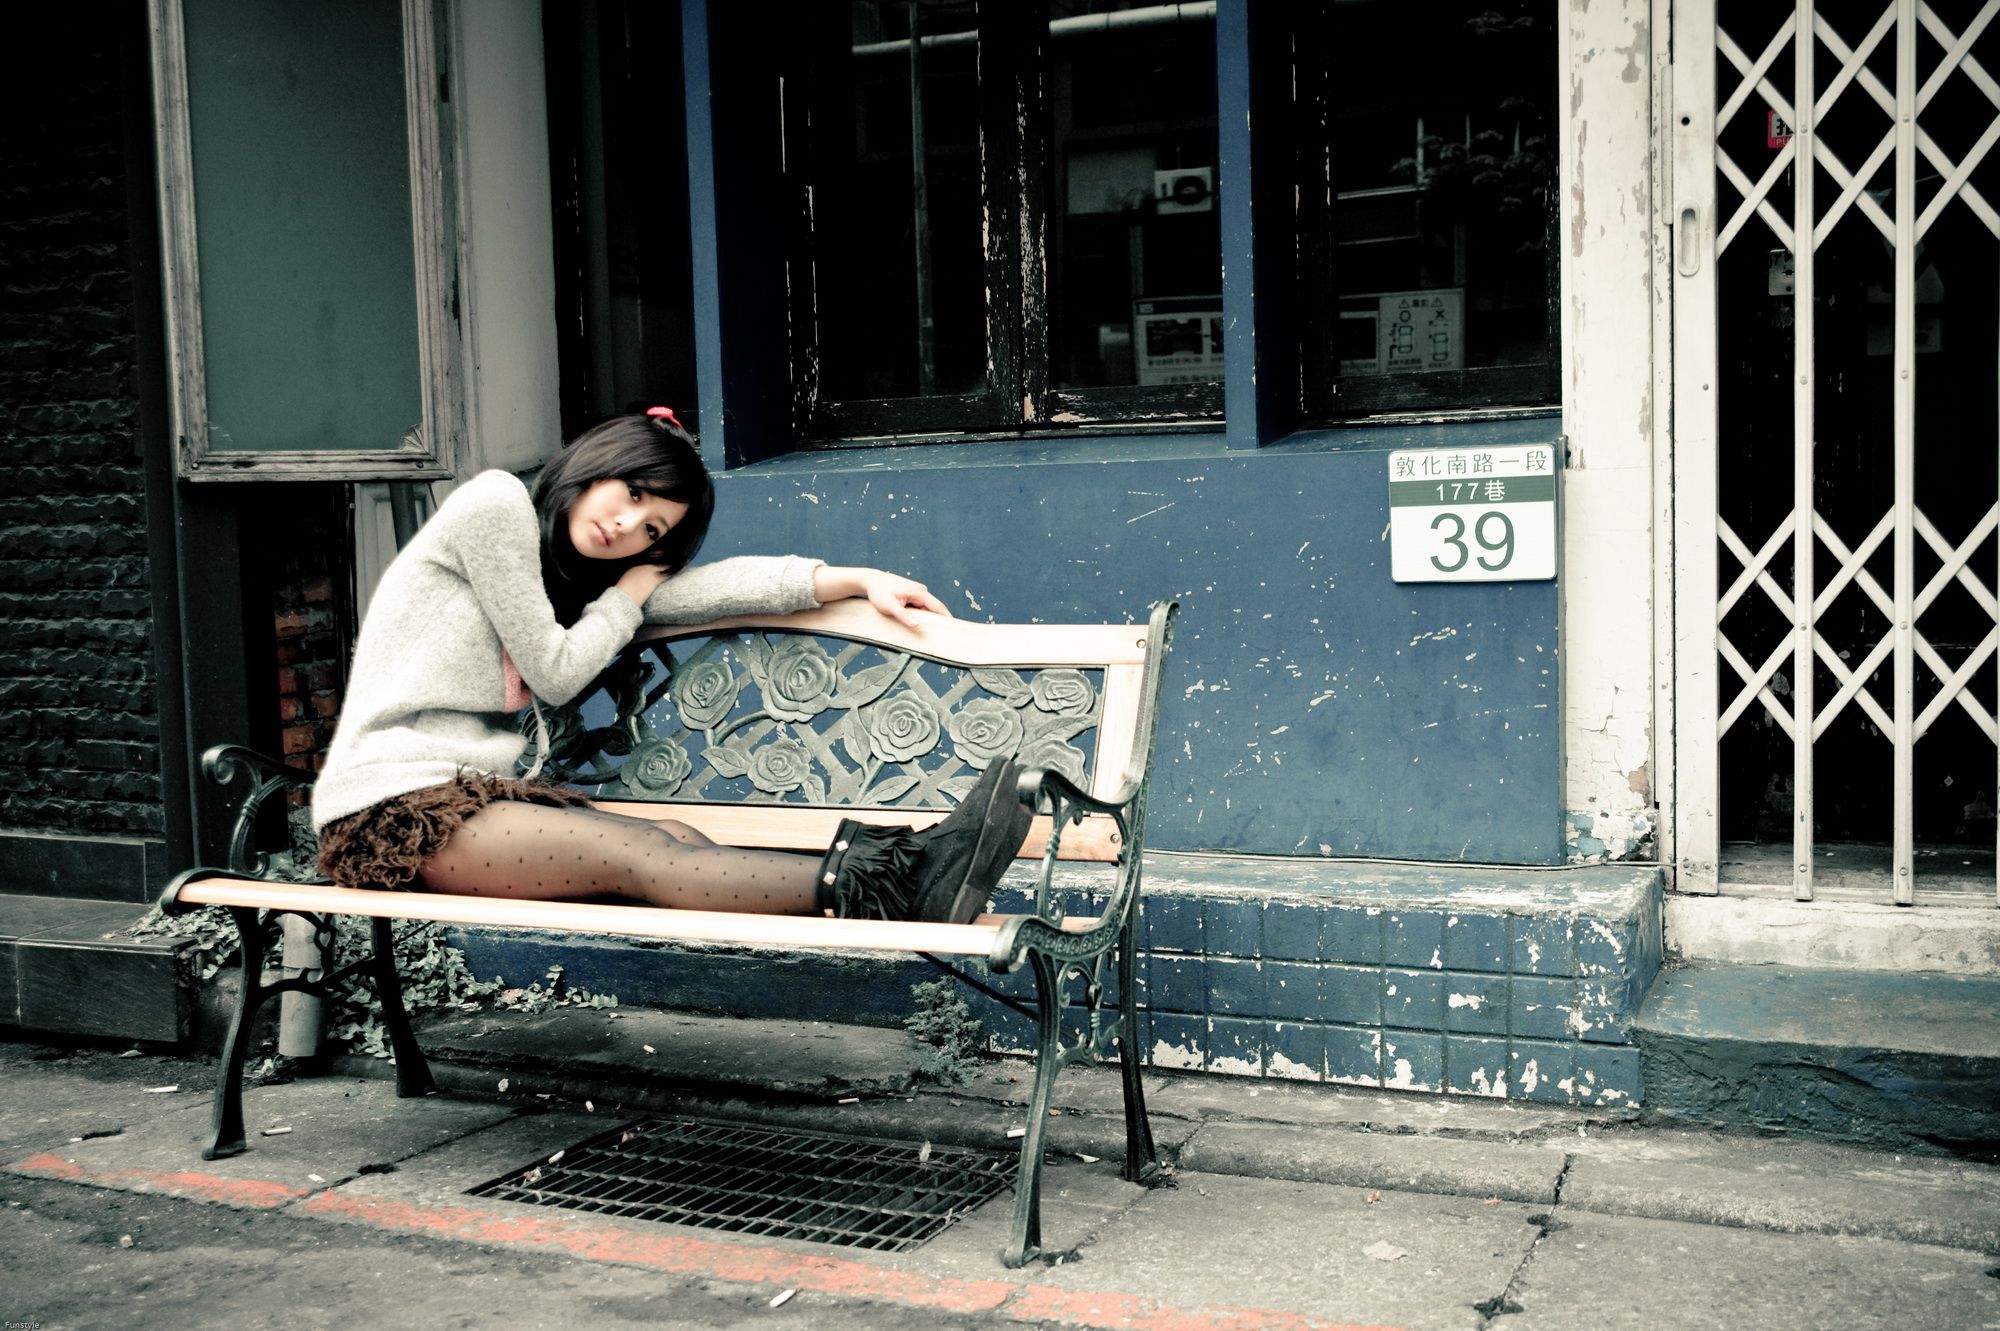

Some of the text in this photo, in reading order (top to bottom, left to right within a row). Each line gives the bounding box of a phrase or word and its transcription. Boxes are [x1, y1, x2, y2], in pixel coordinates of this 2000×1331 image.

[1396, 451, 1547, 477] 敦化南路一段
[1436, 480, 1506, 501] 177巷
[1430, 511, 1515, 573] 39
